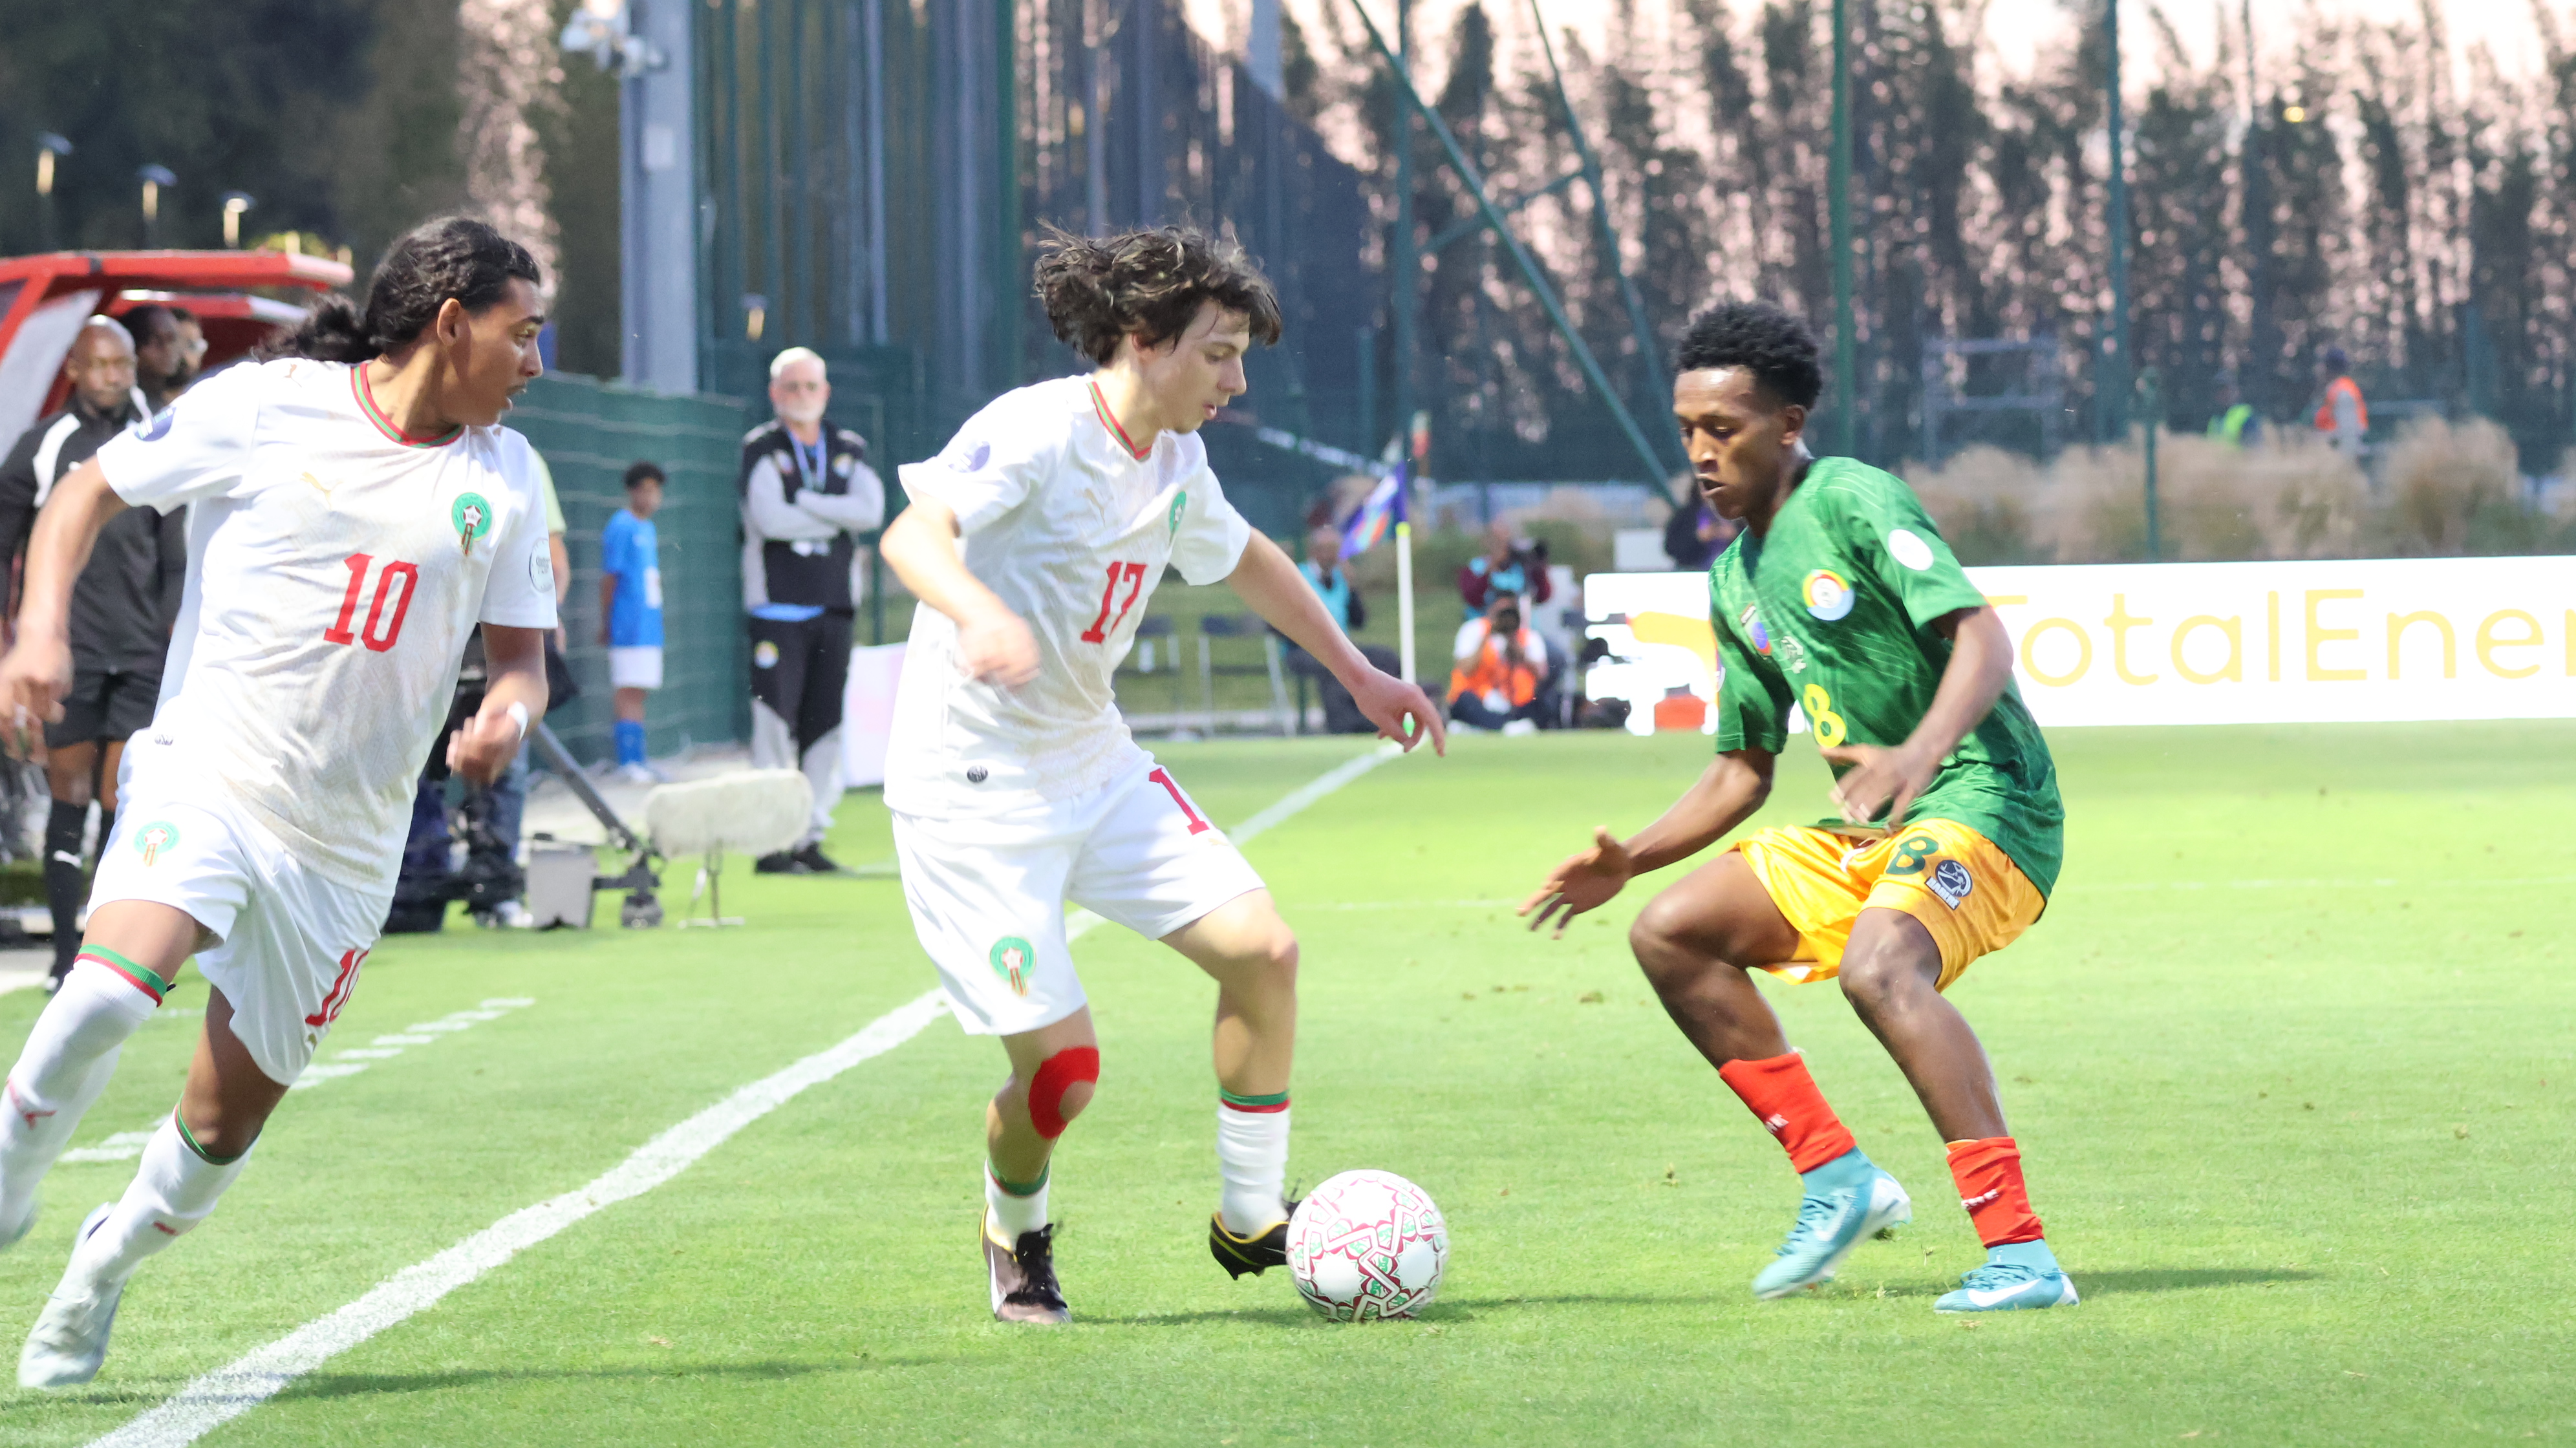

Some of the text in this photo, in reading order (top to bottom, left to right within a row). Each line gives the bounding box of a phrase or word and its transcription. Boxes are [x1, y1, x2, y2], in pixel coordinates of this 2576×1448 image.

[323, 552, 418, 653] 10
[1081, 561, 1148, 644] 17
[1803, 683, 1847, 748] 8
[1885, 836, 1939, 875] 8
